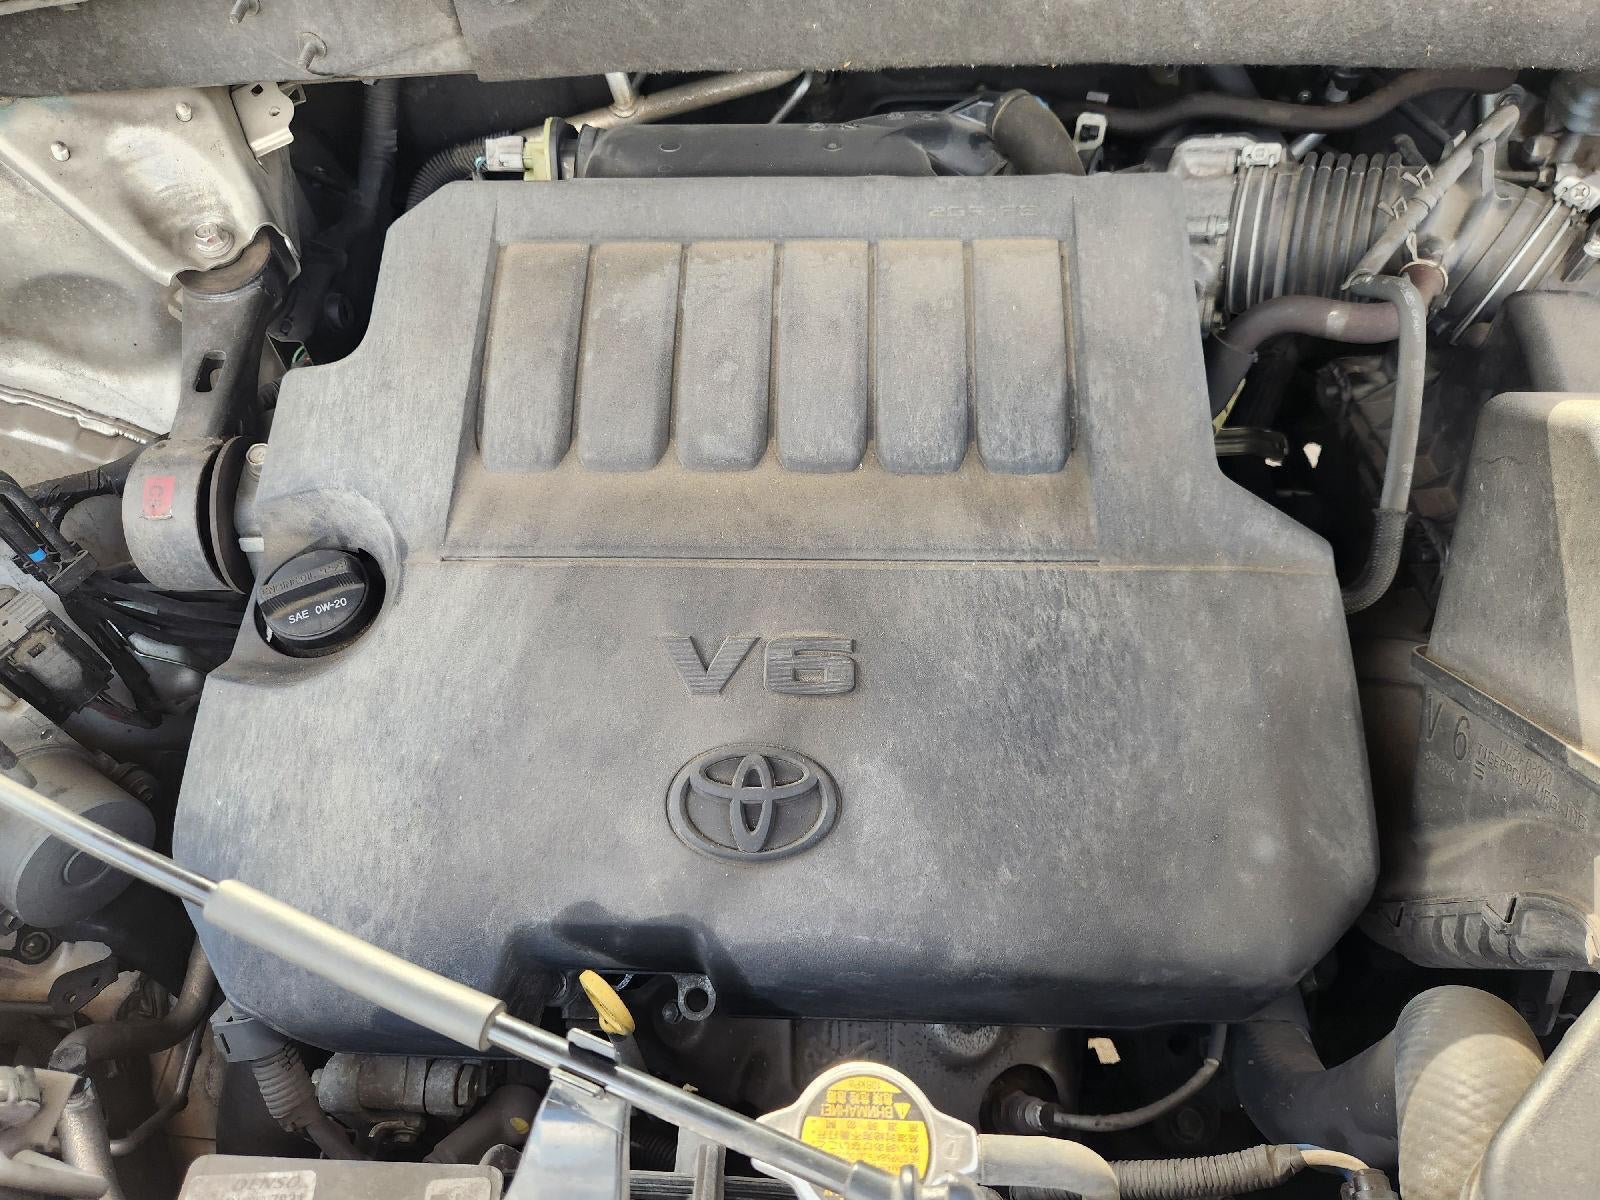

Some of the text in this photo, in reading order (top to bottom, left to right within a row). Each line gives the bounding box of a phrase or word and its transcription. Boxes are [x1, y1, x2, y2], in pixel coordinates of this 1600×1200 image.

[288, 597, 347, 624] SAE 0W-20
[664, 633, 857, 696] V6
